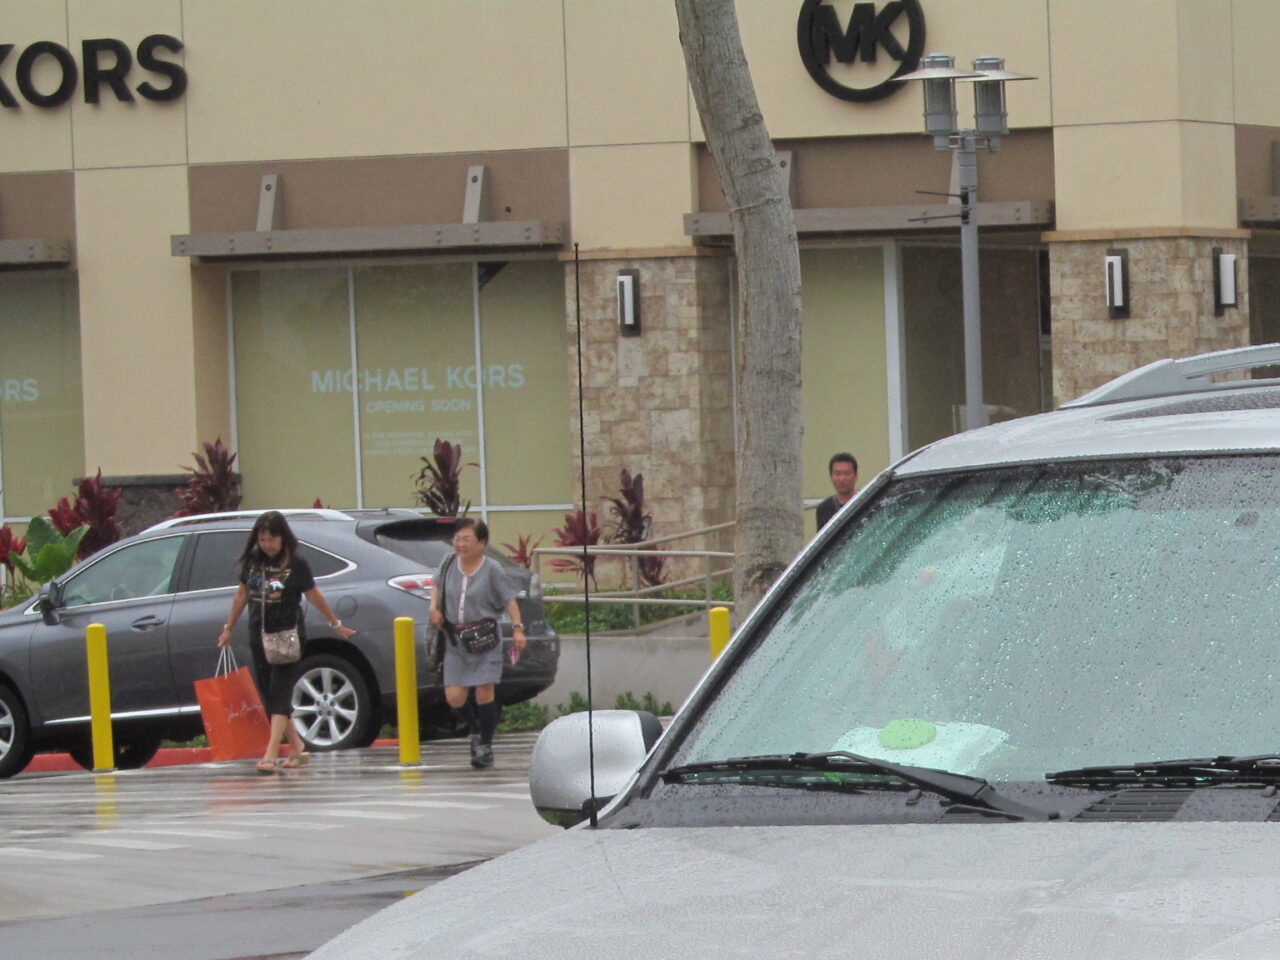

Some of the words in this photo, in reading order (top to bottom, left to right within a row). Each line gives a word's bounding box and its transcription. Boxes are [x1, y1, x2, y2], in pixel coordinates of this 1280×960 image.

[806, 0, 912, 66] MK
[0, 34, 187, 108] KORS
[311, 367, 436, 393] MICHAEL
[446, 364, 525, 389] KORS
[366, 400, 424, 413] OPENING
[431, 398, 472, 412] SOON
